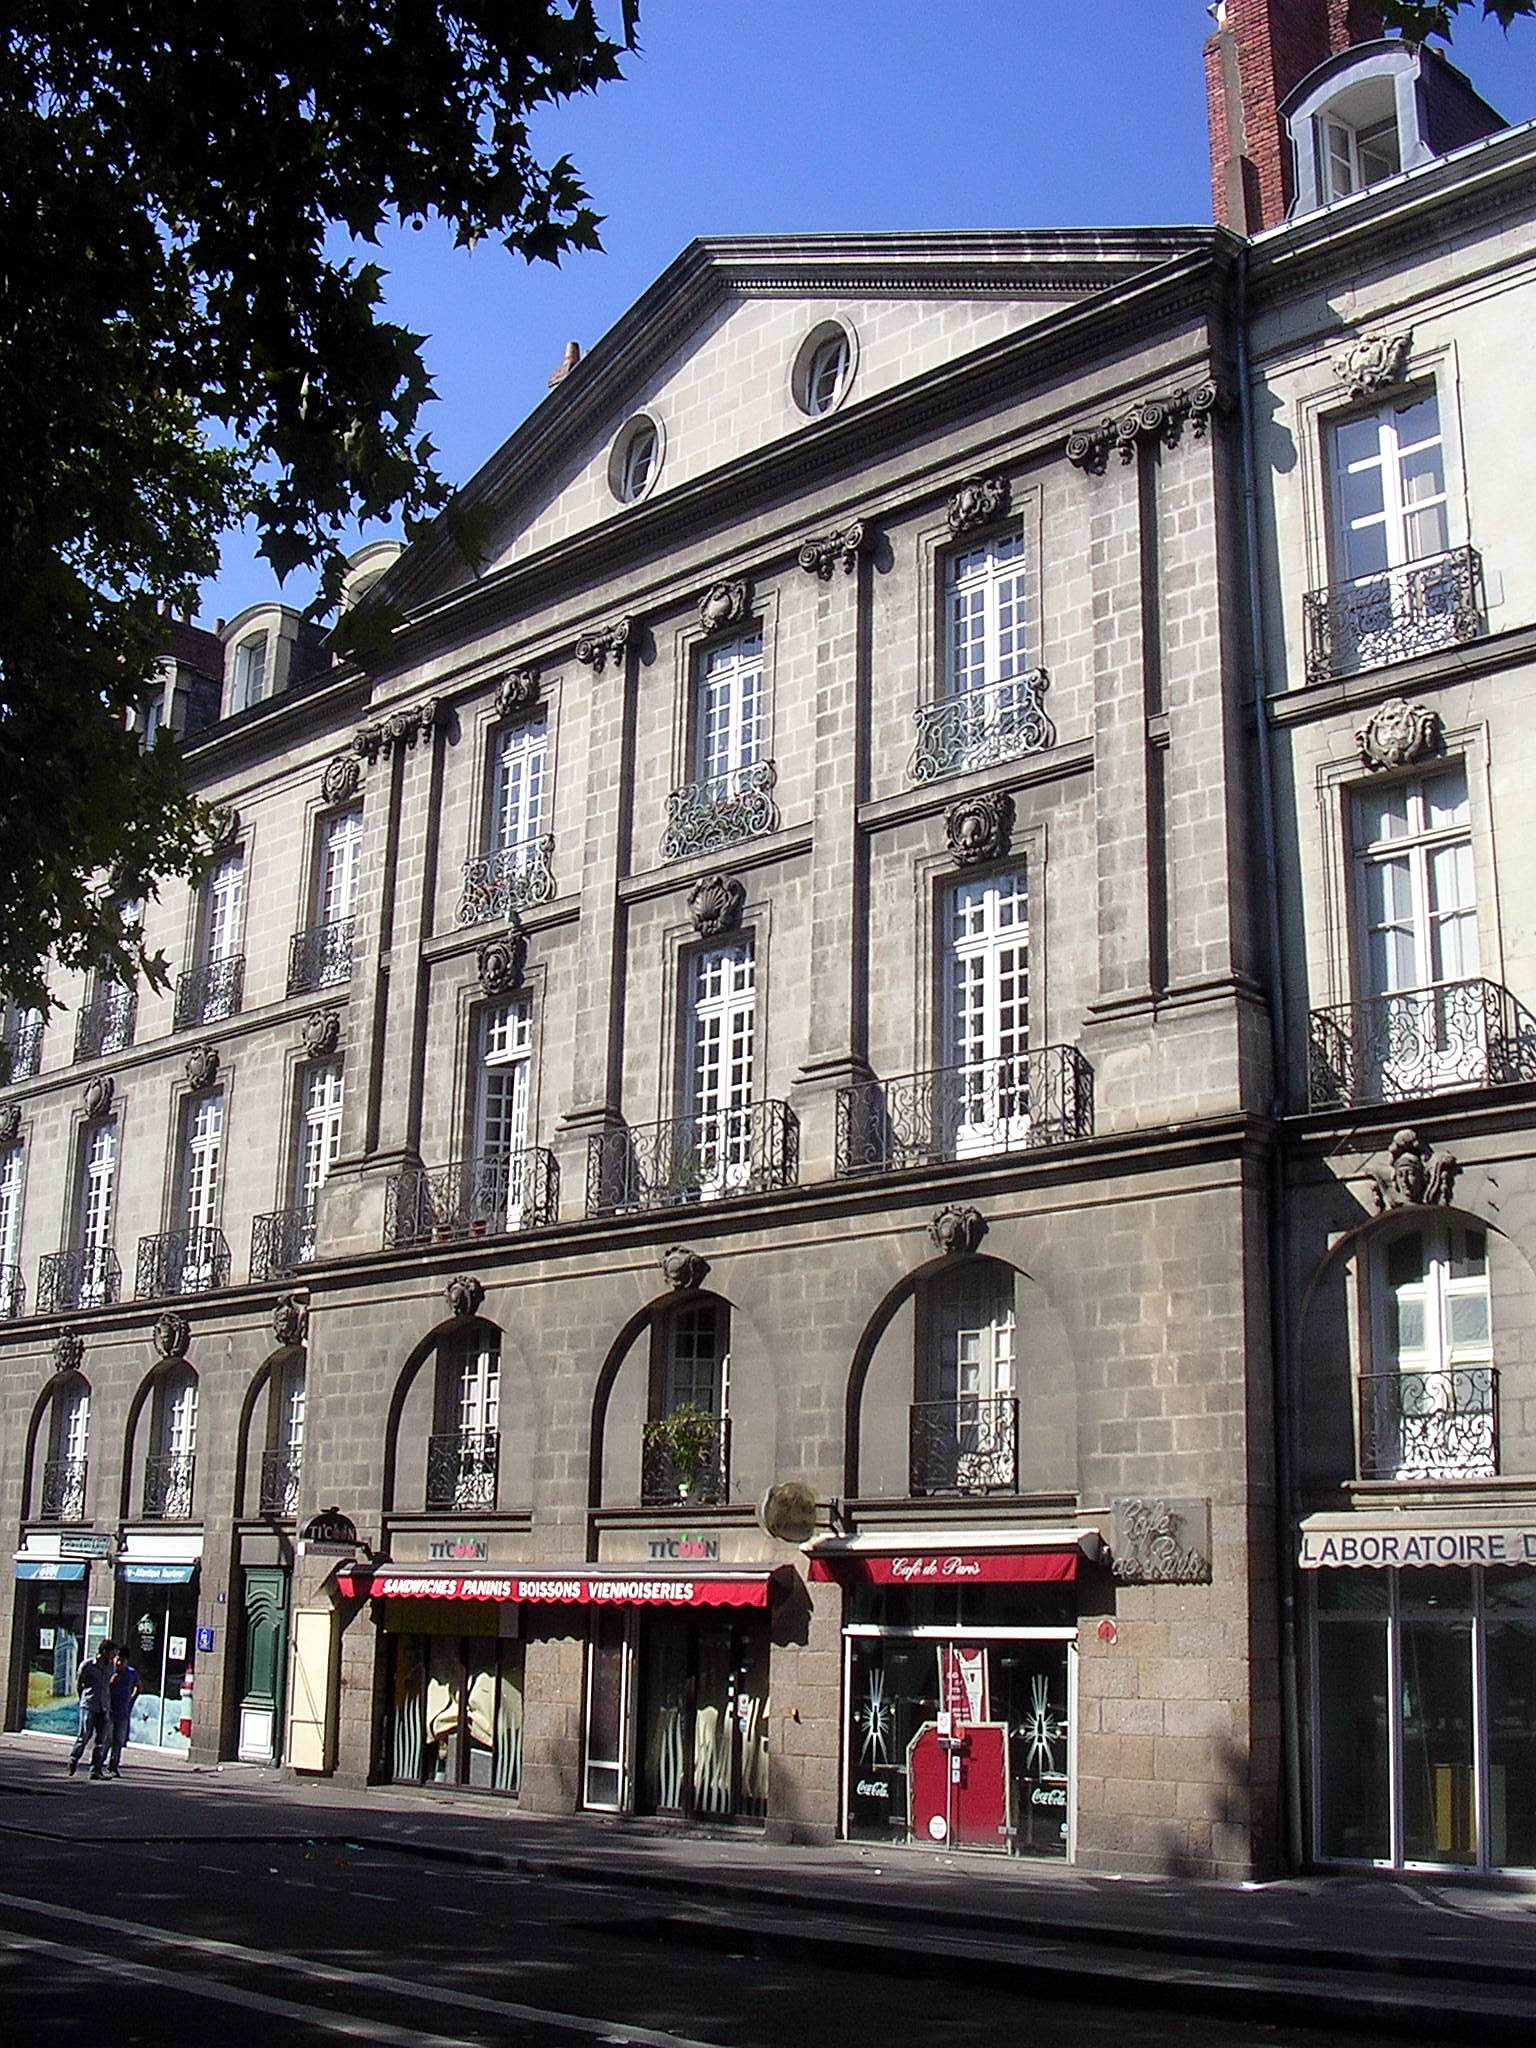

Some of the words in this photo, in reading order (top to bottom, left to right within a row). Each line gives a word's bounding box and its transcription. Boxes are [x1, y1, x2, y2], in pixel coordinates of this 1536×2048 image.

[1303, 1535, 1506, 1561] LABORATOIRE
[892, 1558, 923, 1581] Café
[922, 1559, 938, 1575] de
[942, 1557, 981, 1575] Paris
[382, 1578, 457, 1595] SANDWICHES
[461, 1580, 511, 1596] PANINIS
[518, 1581, 581, 1598] BOISSONS
[588, 1582, 694, 1600] VIENNOISERIES
